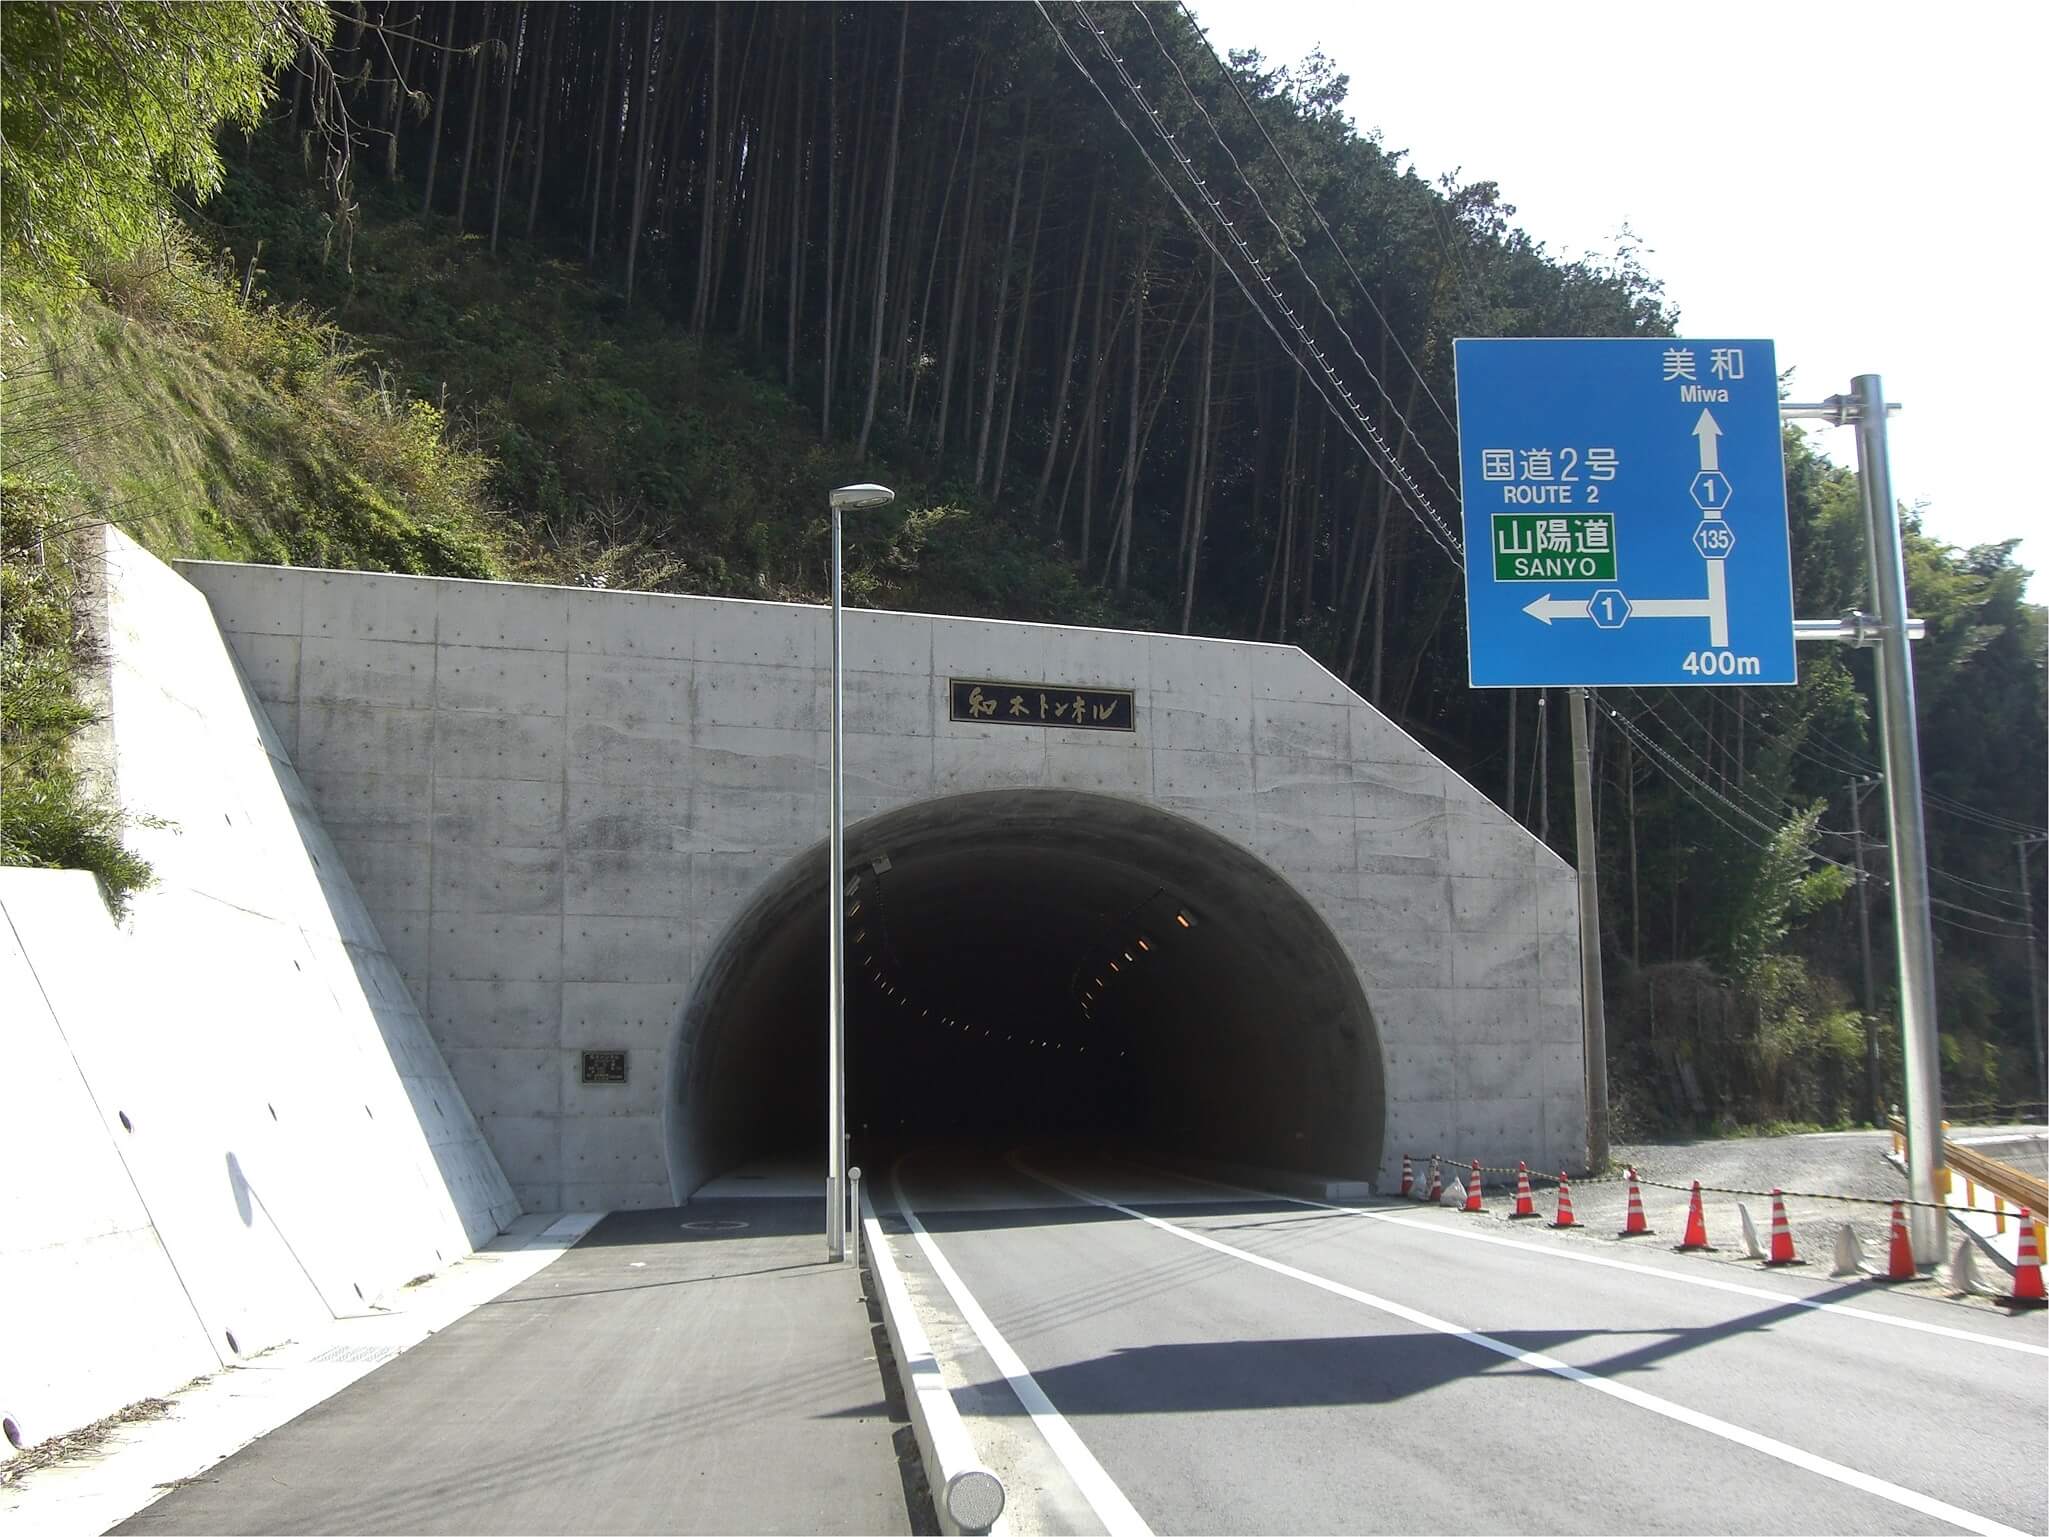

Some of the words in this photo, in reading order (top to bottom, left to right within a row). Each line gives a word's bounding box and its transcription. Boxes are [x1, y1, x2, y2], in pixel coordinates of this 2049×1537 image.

[1663, 347, 1744, 381] 美和
[1680, 385, 1729, 403] Miwa
[1482, 447, 1620, 481] 国道2号
[1503, 485, 1572, 504] ROUTE
[1586, 485, 1600, 504] 2
[1703, 479, 1714, 502] 1
[1498, 519, 1610, 554] 山陽道
[1700, 529, 1729, 549] 135
[1514, 557, 1597, 577] SANYO
[1601, 597, 1613, 621] 1
[1682, 651, 1761, 676] 400m
